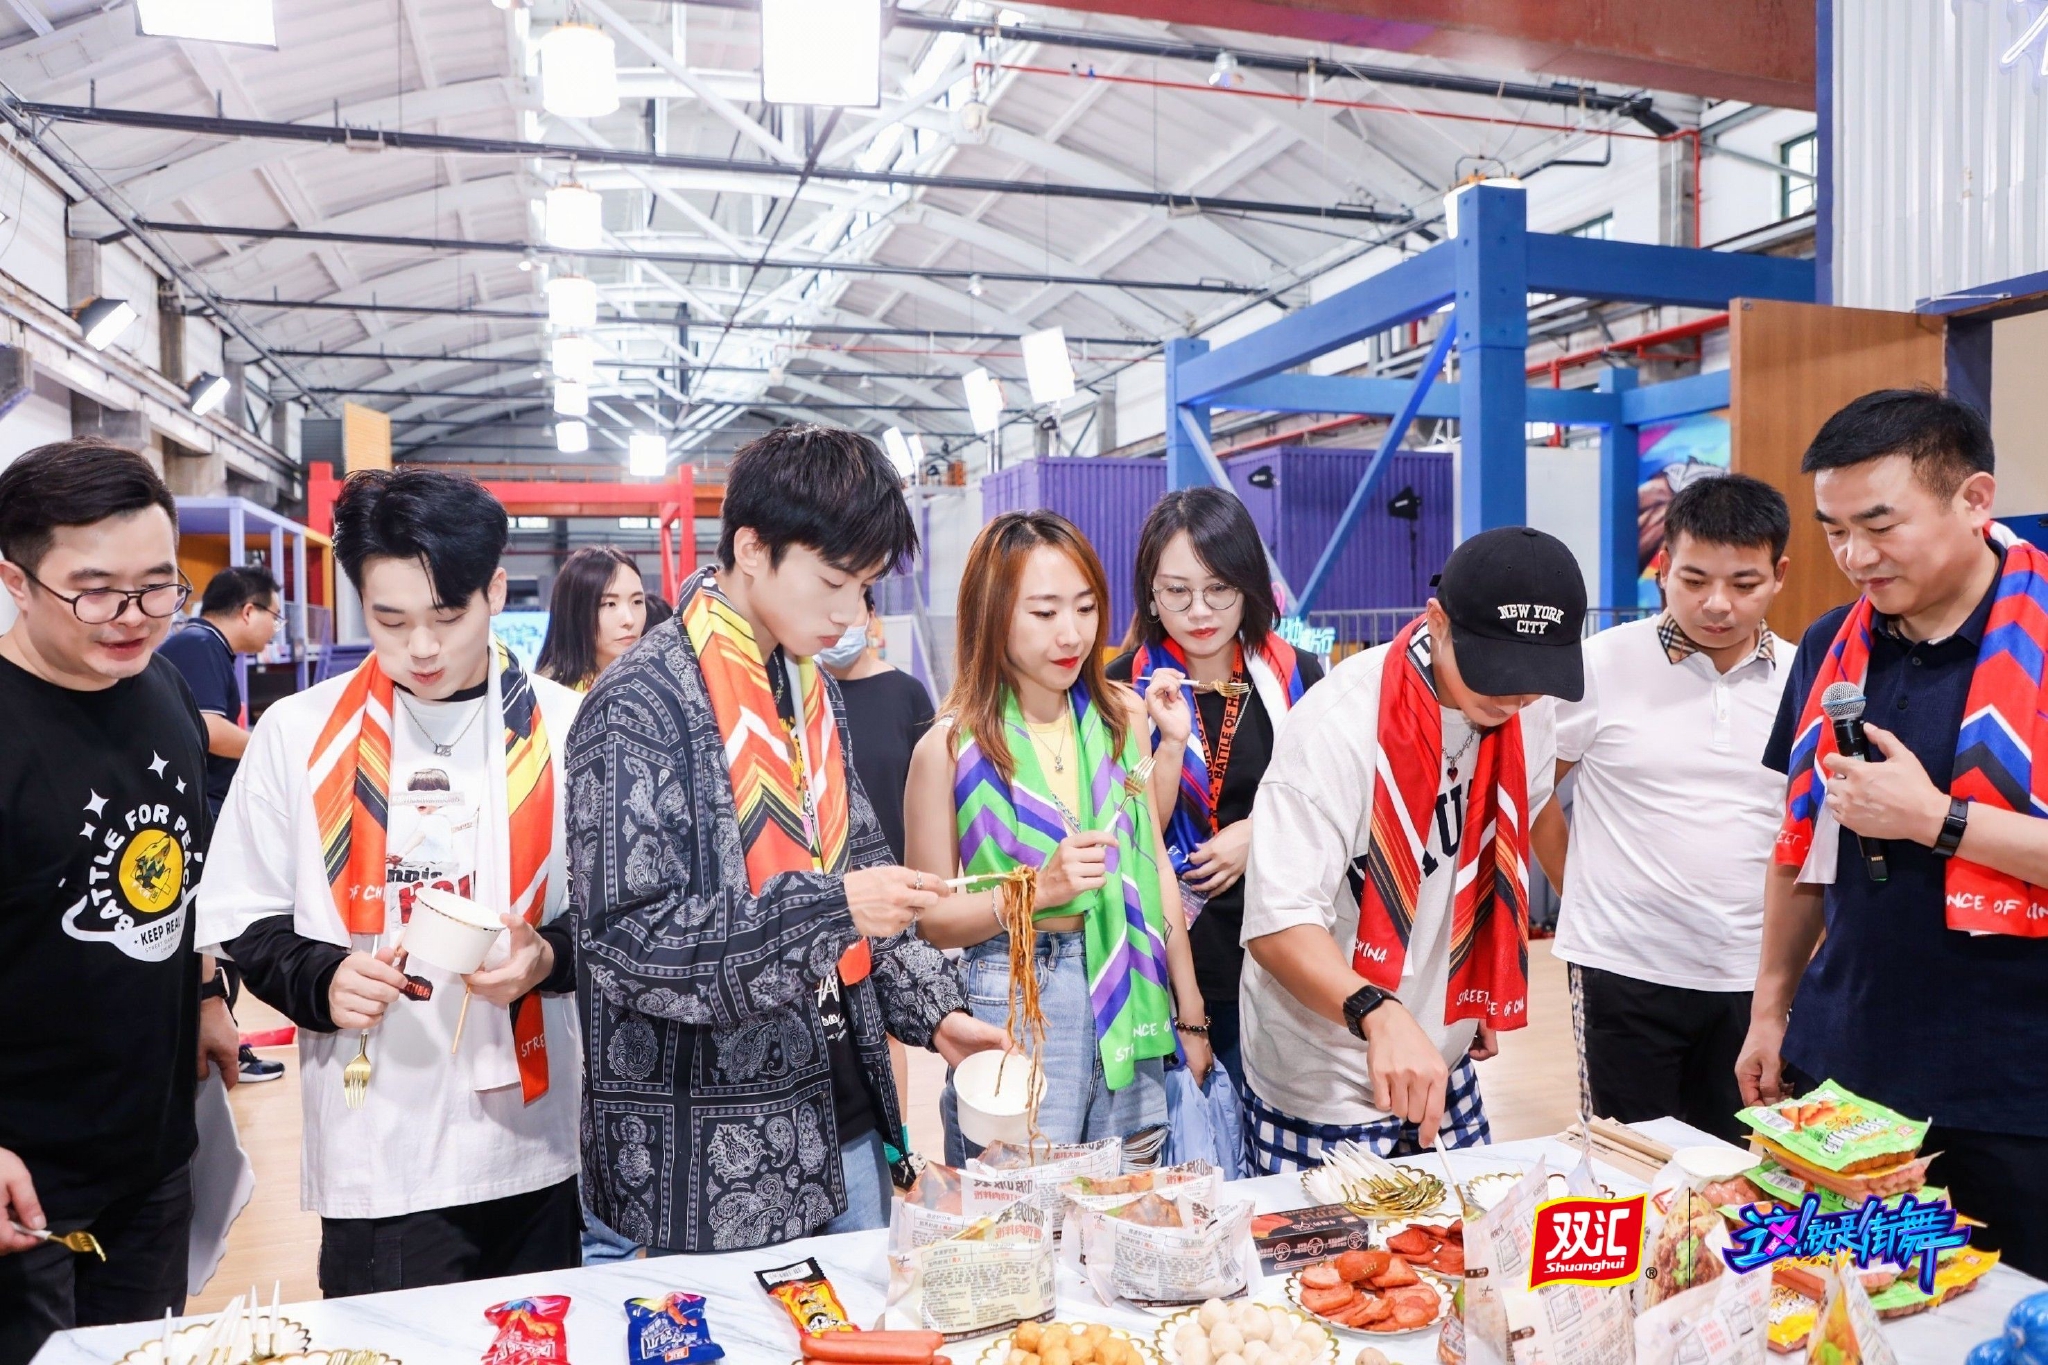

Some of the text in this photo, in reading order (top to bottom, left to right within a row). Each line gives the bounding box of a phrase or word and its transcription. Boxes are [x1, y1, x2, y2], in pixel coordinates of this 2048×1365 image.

[1497, 604, 1565, 625] NEW YORK
[1516, 620, 1548, 635] CITY
[1214, 731, 1232, 780] BATTLE
[1224, 710, 1236, 729] OF
[88, 828, 135, 932] BATTLE
[124, 803, 170, 832] FOR
[1993, 900, 2022, 916] OF
[140, 925, 164, 947] KEEP
